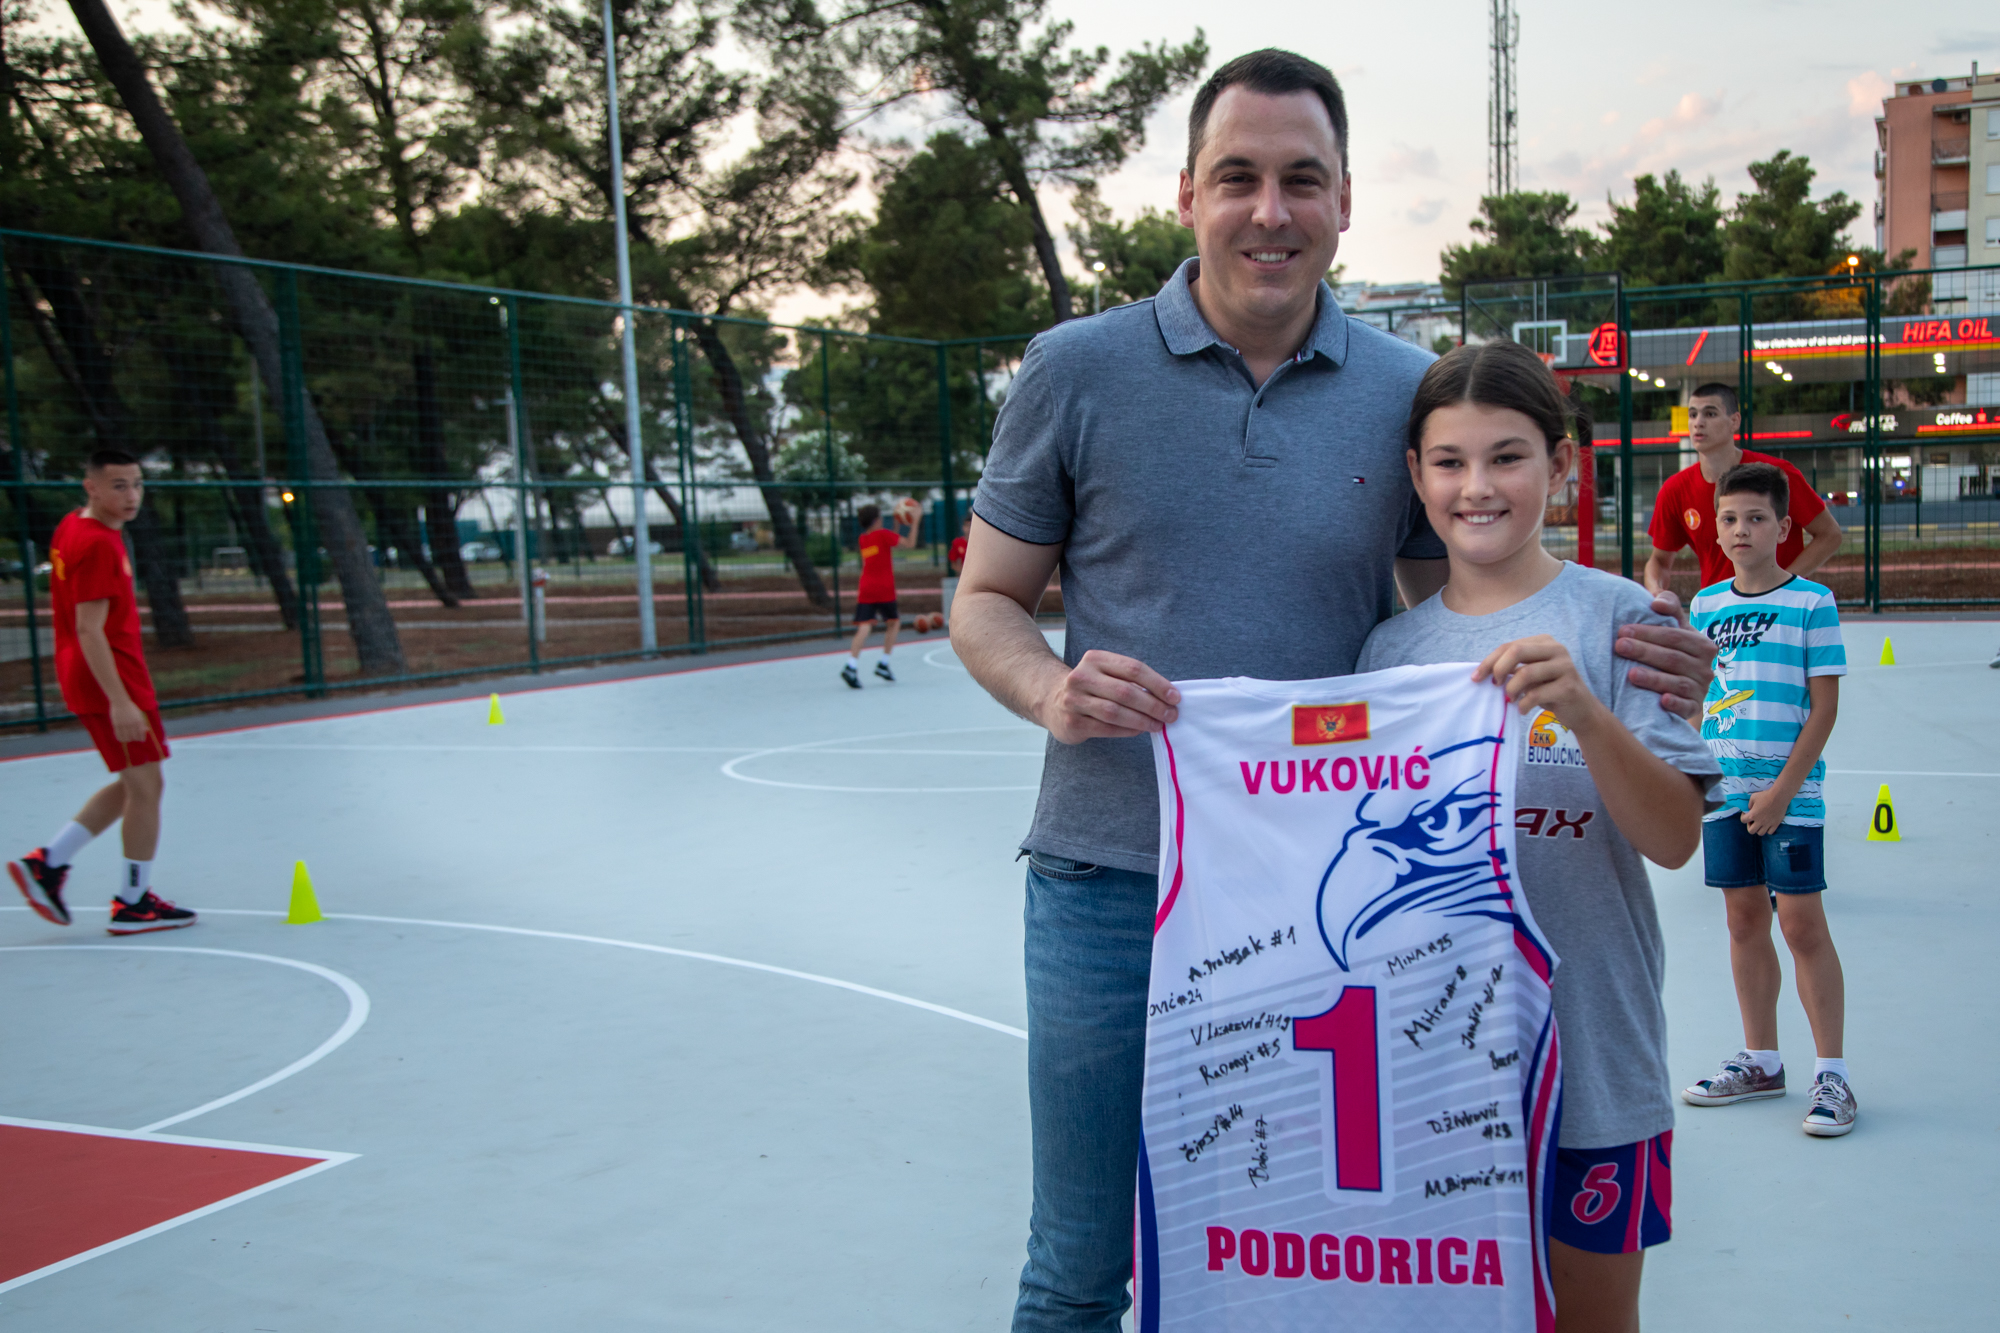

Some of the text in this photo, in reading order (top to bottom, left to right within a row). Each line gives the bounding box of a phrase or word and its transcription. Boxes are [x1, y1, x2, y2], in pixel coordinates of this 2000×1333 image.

[1903, 318, 1993, 343] HIFA OIL
[1935, 412, 1973, 426] Coffee
[1707, 611, 1779, 640] CATCH
[1533, 729, 1551, 744] ŽKK
[1239, 745, 1431, 795] VUKOVIĆ
[1874, 803, 1894, 834] 0
[1292, 985, 1384, 1192] 1
[1570, 1162, 1621, 1225] 5
[1206, 1225, 1504, 1287] PODGORICA
